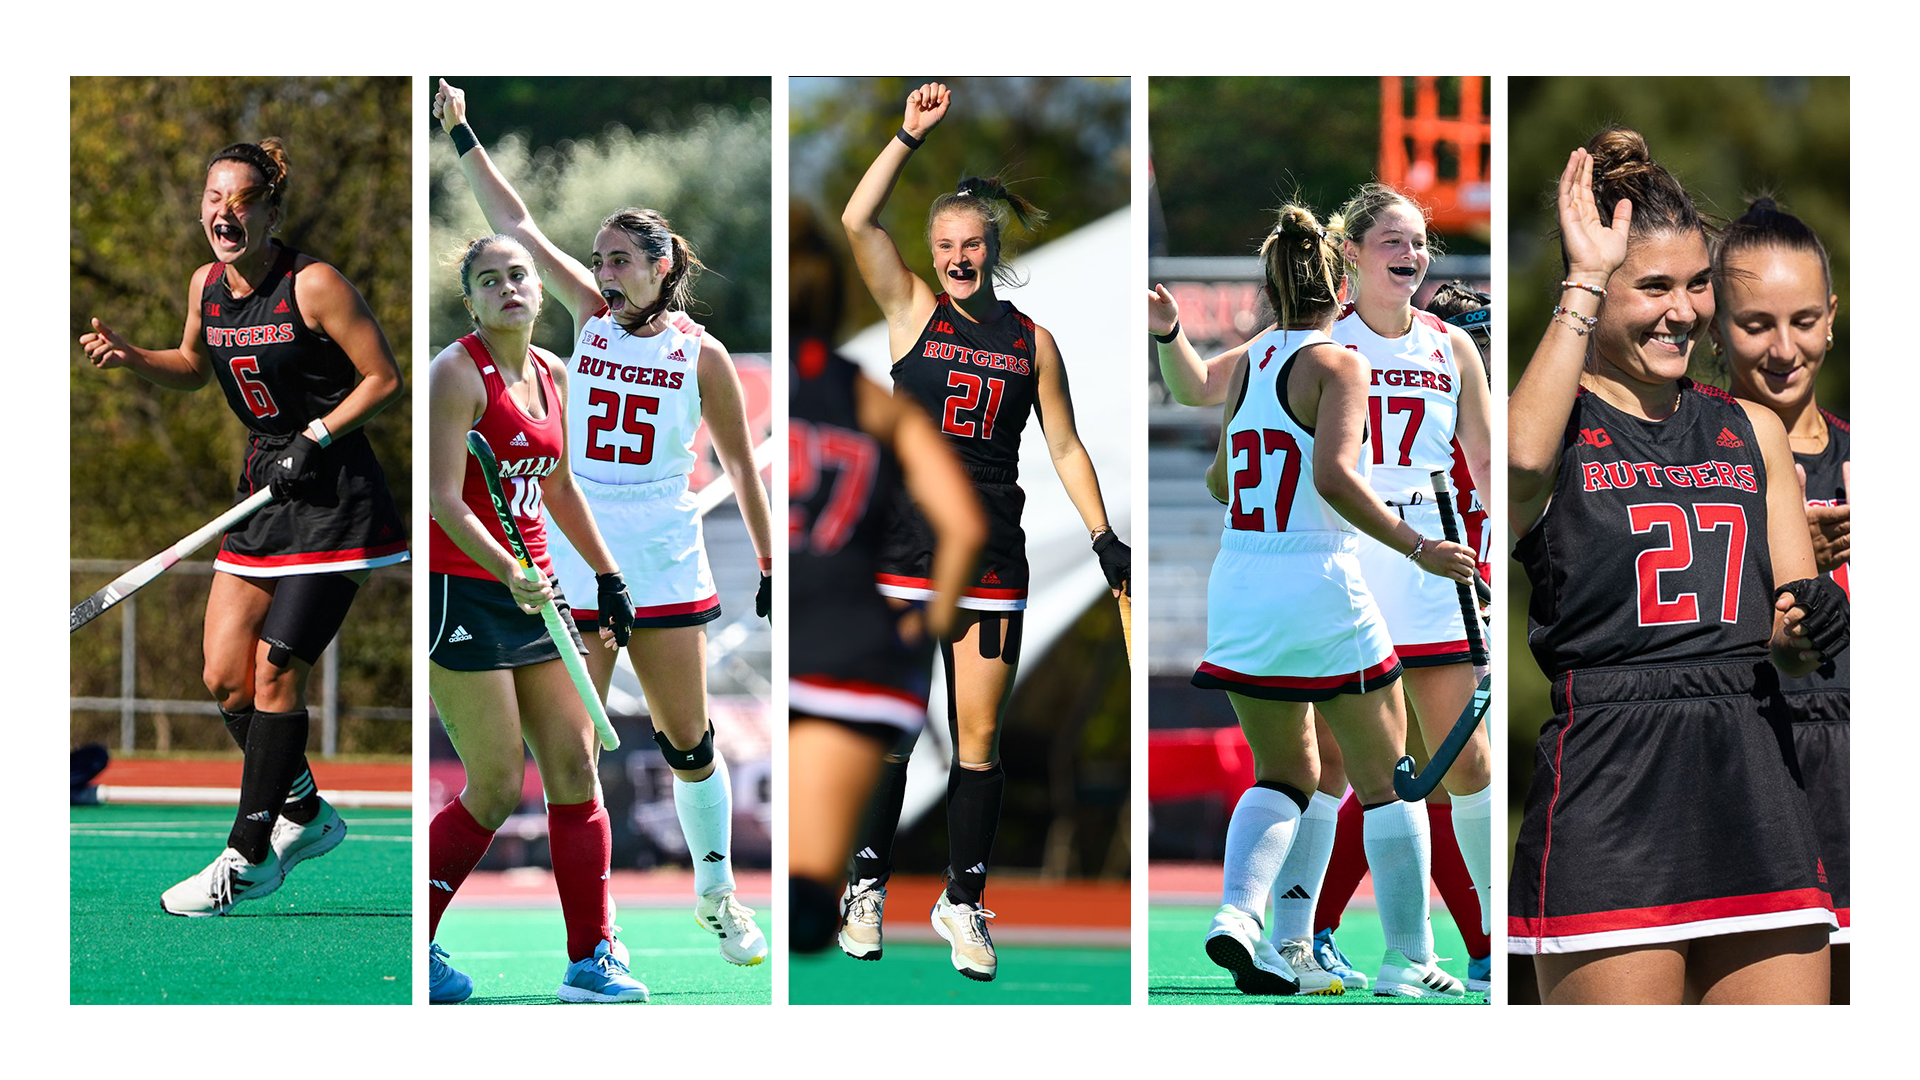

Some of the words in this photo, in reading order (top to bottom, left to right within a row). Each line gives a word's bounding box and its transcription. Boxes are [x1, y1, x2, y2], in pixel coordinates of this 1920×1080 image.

[206, 323, 295, 347] RUTGERS
[577, 355, 685, 390] RUTGERS
[922, 340, 1031, 376] RUTGERS
[229, 356, 279, 419] 6
[1370, 369, 1452, 393] TGERS
[585, 387, 660, 466] 25
[941, 370, 1005, 440] 21
[1368, 396, 1425, 466] 17
[499, 456, 560, 478] MIAM
[1230, 428, 1302, 533] 27
[1581, 460, 1758, 493] RUTGERS
[510, 476, 542, 520] 10
[1627, 502, 1748, 627] 27
